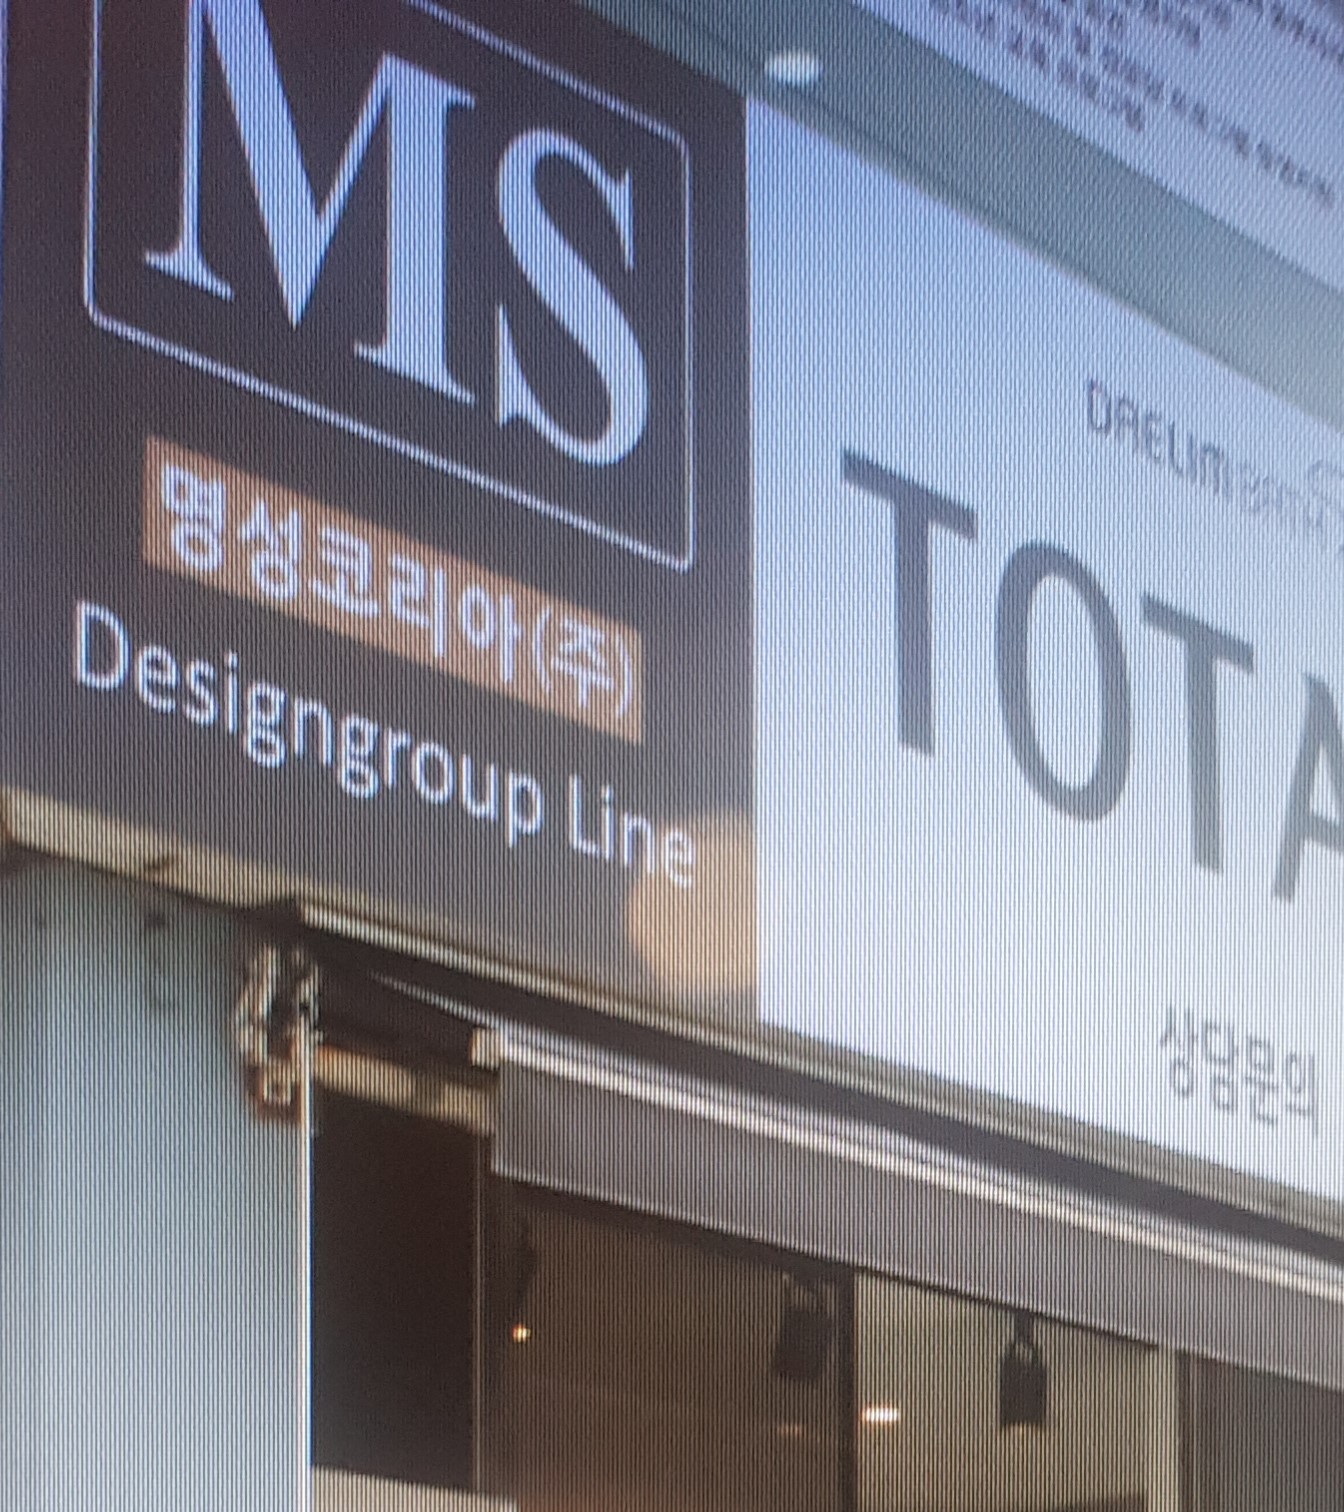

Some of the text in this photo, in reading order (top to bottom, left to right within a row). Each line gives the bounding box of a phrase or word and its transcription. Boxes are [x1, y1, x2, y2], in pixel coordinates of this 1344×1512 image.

[142, 0, 650, 467] MS
[160, 461, 636, 719] 명성코리아(주)
[71, 598, 698, 890] Designgroup Line
[1159, 1013, 1319, 1128] 상담문의
